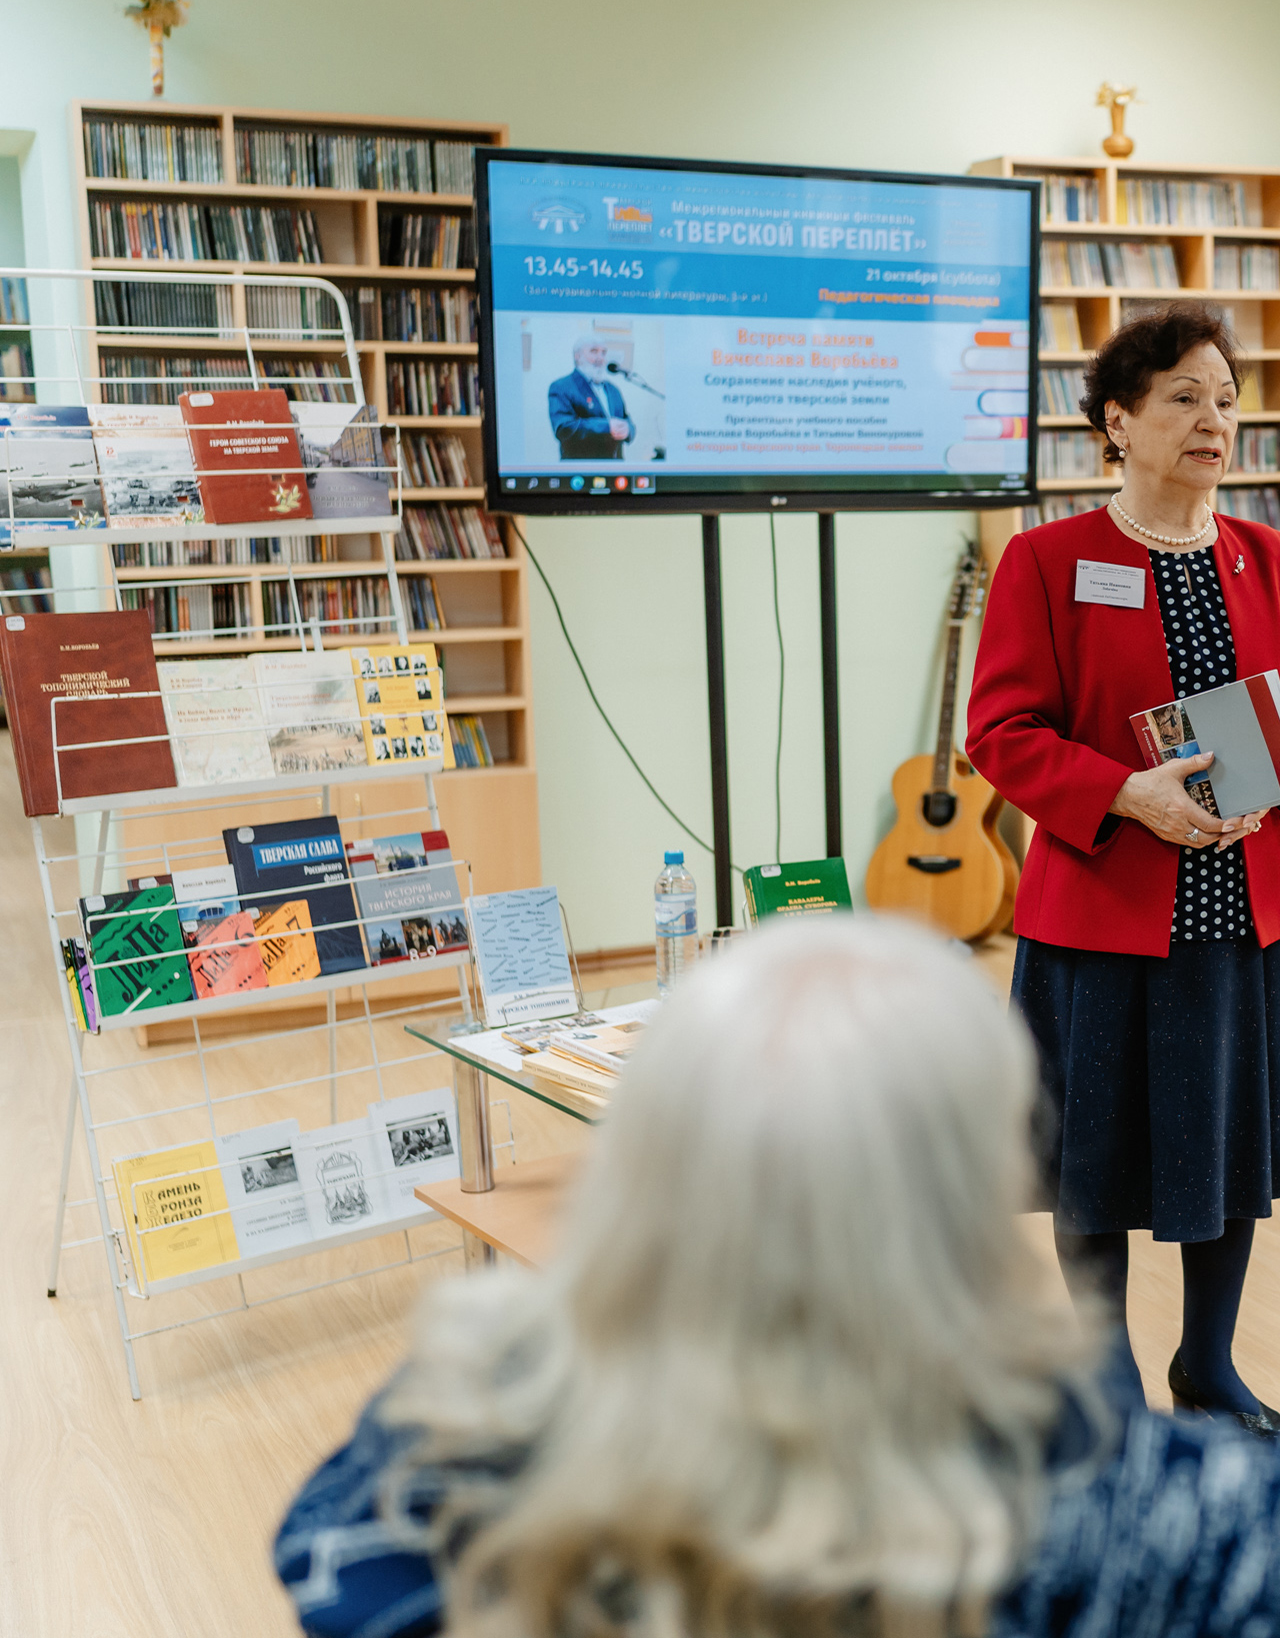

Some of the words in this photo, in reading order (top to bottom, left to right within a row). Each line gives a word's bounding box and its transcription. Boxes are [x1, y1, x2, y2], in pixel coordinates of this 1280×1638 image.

[671, 200, 790, 219] Межрегиональный
[854, 210, 916, 225] фестиваль
[658, 219, 794, 247] «ТВЕРСКОЙ
[802, 225, 927, 252] ПЕРЕПЛЁТ»
[523, 256, 644, 279] 13.45-14.45
[866, 268, 880, 281] 21
[882, 271, 938, 285] октября
[939, 271, 1001, 287] (суббота)
[818, 288, 930, 304] Педагогическая
[737, 328, 806, 348] Встреча
[811, 333, 874, 347] памяти
[711, 349, 805, 367] Вячеслава
[810, 351, 898, 370] Воробьёва
[704, 373, 785, 388] Сохранение
[787, 376, 849, 389] наследия
[852, 376, 907, 390] учёного,
[722, 393, 784, 407] патриота
[787, 392, 847, 406] тверской
[850, 395, 890, 405] земли
[686, 428, 742, 438] Вячеслава
[209, 438, 229, 447] ГЕРОИ
[229, 437, 267, 447] СОВЕТСКОГО
[267, 436, 289, 445] СОЮЗА
[223, 447, 232, 455] НА
[233, 446, 261, 454] ТВЕРСКОЙ
[40, 677, 131, 692] ТОПОНИМИЧЕСКИЙ
[60, 670, 108, 683] ТВЕРСКОЙ
[259, 844, 308, 864] ТВЕРСКАЯ
[308, 839, 340, 857] СЛАВА
[304, 862, 343, 876] Российского
[323, 873, 345, 884] флота
[384, 882, 432, 900] ИСТОРИЯ
[367, 895, 426, 913] ТВЕРСКОГО
[427, 889, 452, 903] КРАЯ
[776, 904, 803, 912] ОРДЕНА
[804, 901, 838, 909] СУВОРОВА
[788, 896, 825, 905] КАВАЛЕРЫ
